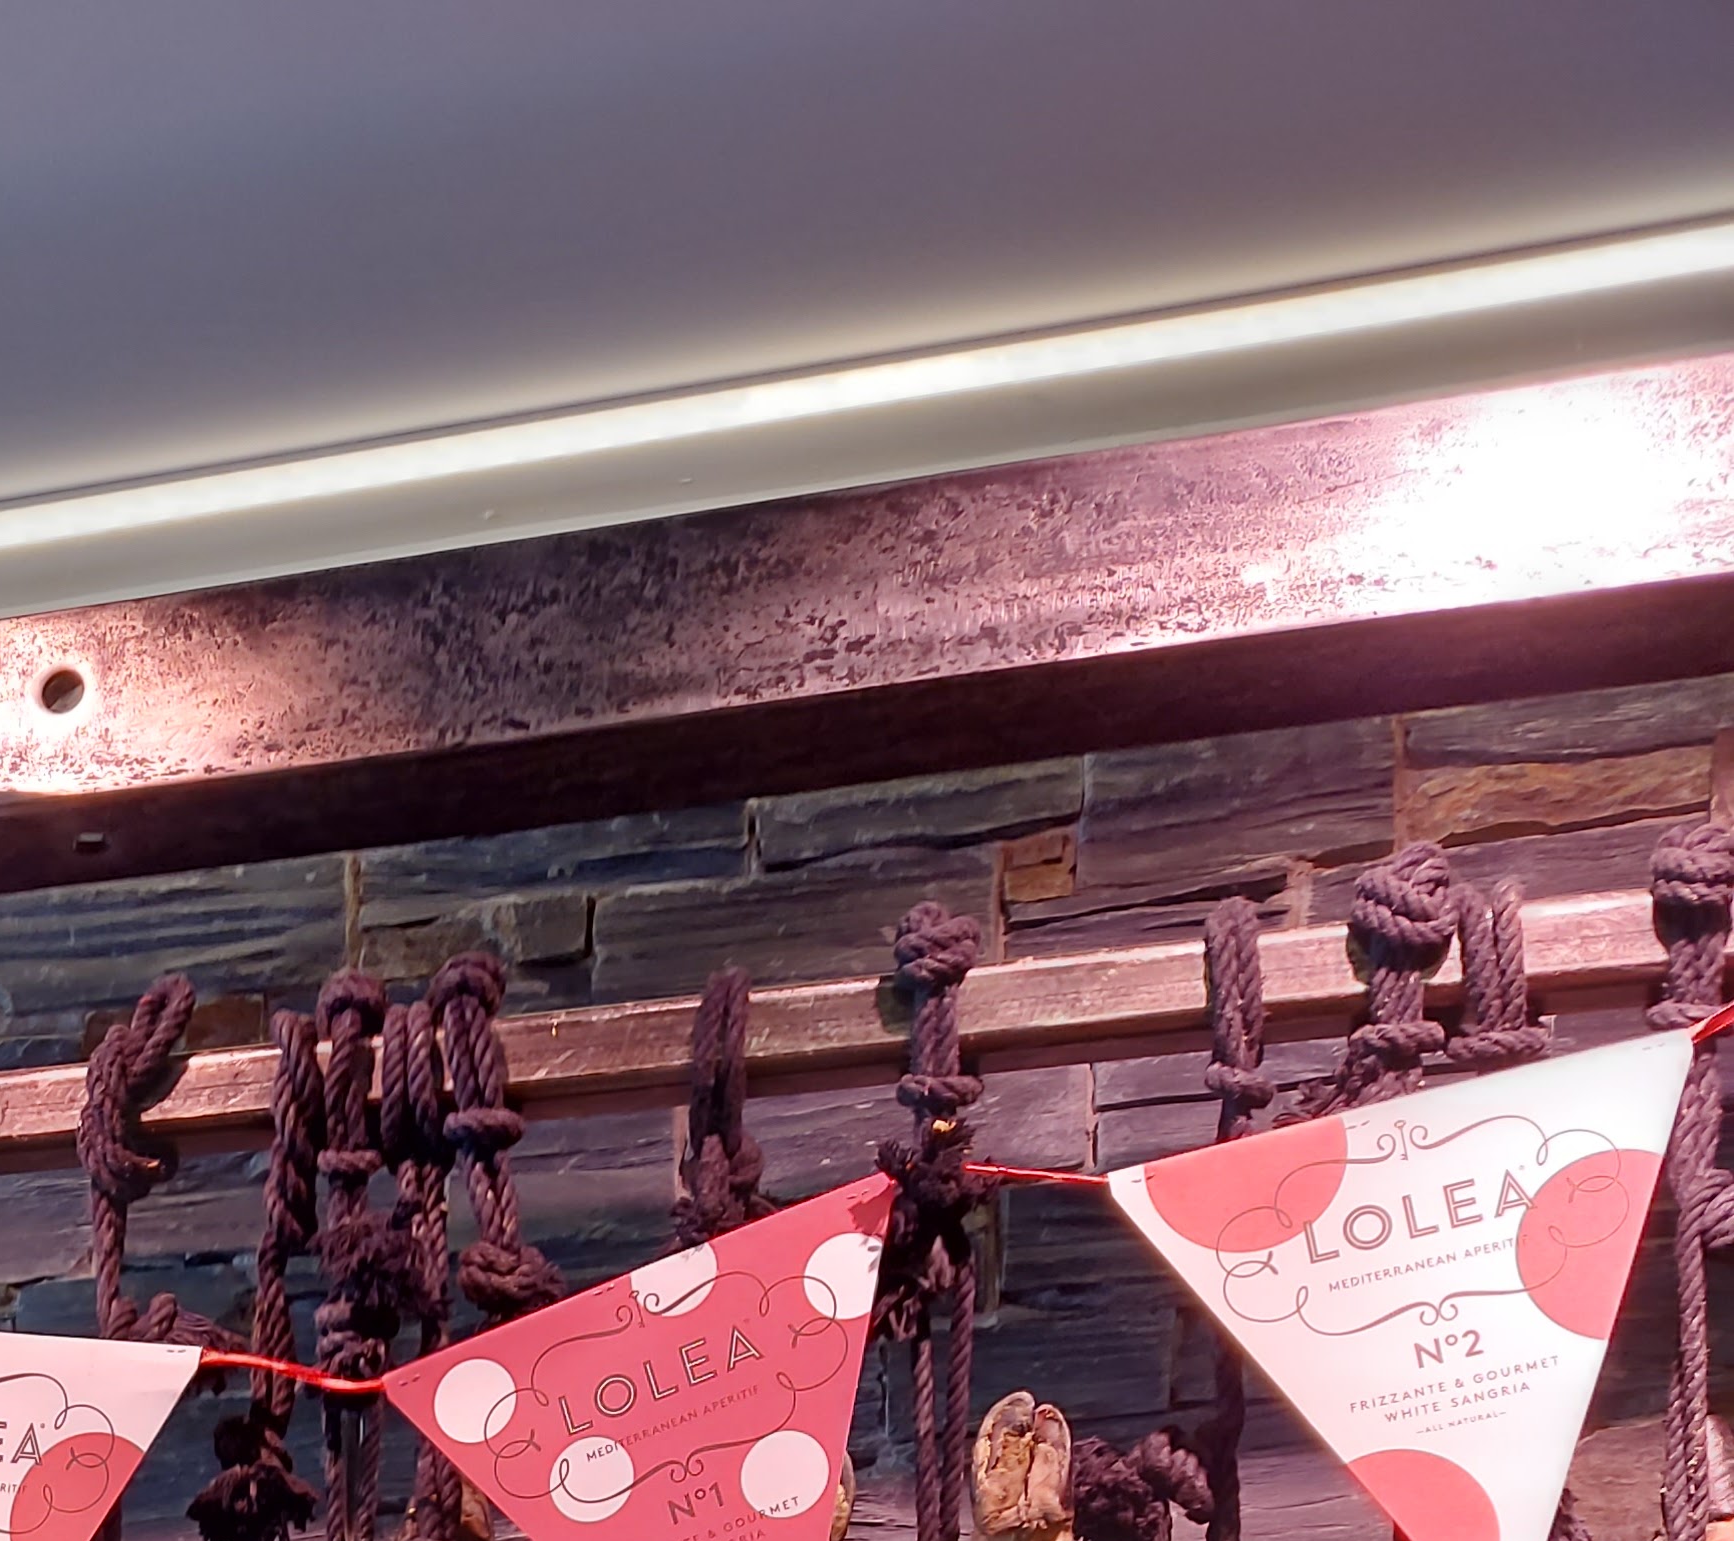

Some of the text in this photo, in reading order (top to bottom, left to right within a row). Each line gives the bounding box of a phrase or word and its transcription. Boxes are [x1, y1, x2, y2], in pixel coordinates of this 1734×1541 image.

[1303, 1169, 1536, 1264] LOLEA
[1328, 1253, 1457, 1292] MEDITERRANEAN
[558, 1325, 764, 1435] LOLEA
[1350, 1356, 1559, 1413] FRIZZANTE & GOURMET
[1384, 1382, 1530, 1423] WHITE SANGRIA
[586, 1385, 759, 1462] MEDITERRANEAN APERITIF
[708, 1529, 716, 1539] &
[723, 1496, 800, 1533] GOURMET
